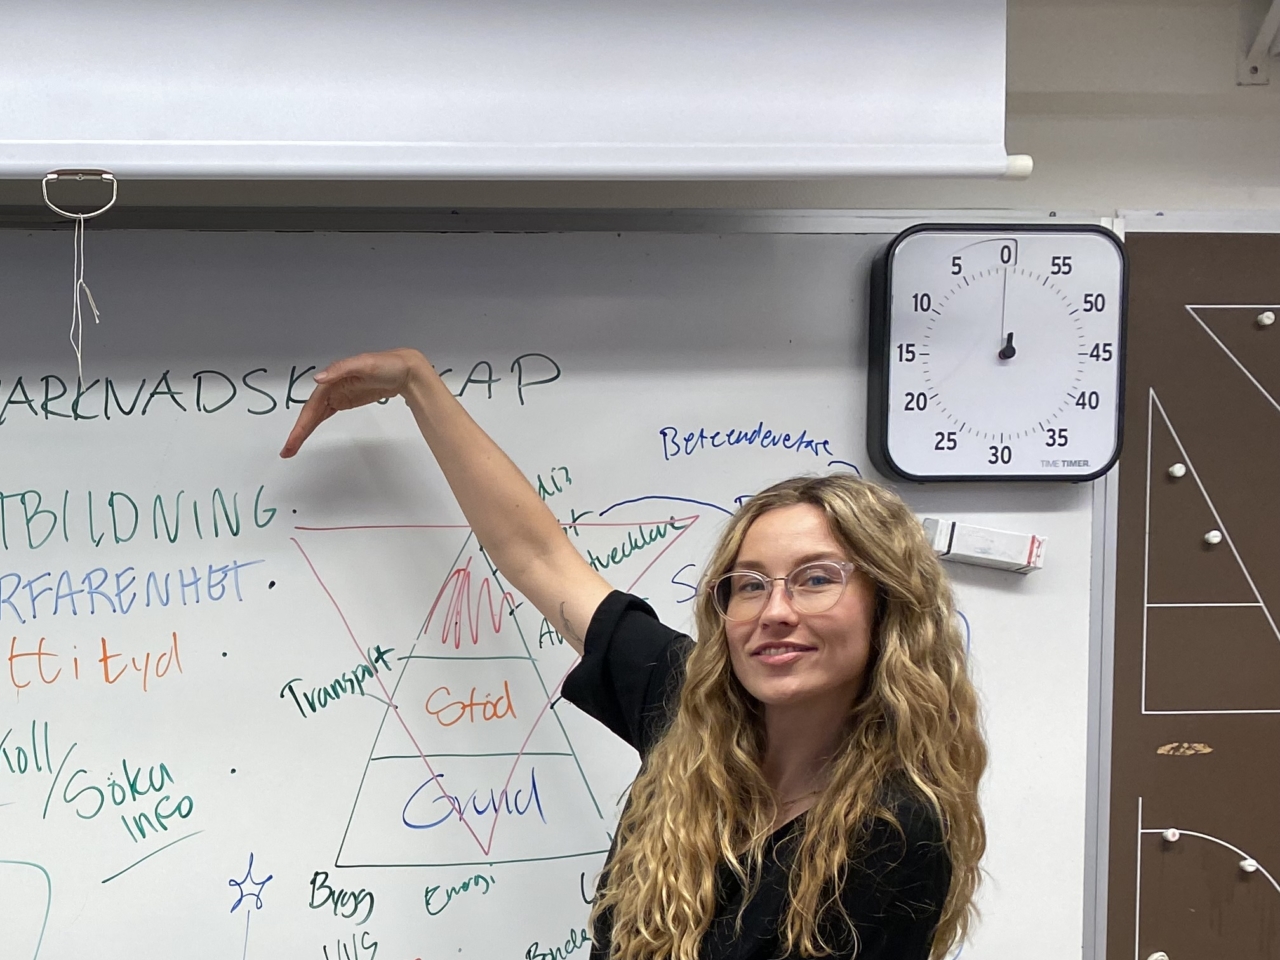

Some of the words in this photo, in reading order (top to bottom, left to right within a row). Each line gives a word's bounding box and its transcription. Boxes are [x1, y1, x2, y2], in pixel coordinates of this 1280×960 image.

[1000, 245, 1011, 264] 0
[951, 256, 962, 275] 5
[1051, 256, 1072, 274] 55
[912, 293, 931, 312] 10
[1083, 293, 1106, 312] 50
[897, 344, 916, 363] 15
[1089, 343, 1113, 361] 45
[904, 392, 927, 411] 20
[1075, 391, 1100, 409] 40
[934, 432, 957, 450] 25
[1045, 429, 1068, 446] 35
[988, 446, 1012, 464] 30
[1041, 460, 1060, 468] TIME
[280, 645, 395, 718] Transport
[426, 680, 517, 726] Stöd
[309, 871, 375, 926] Bygg
